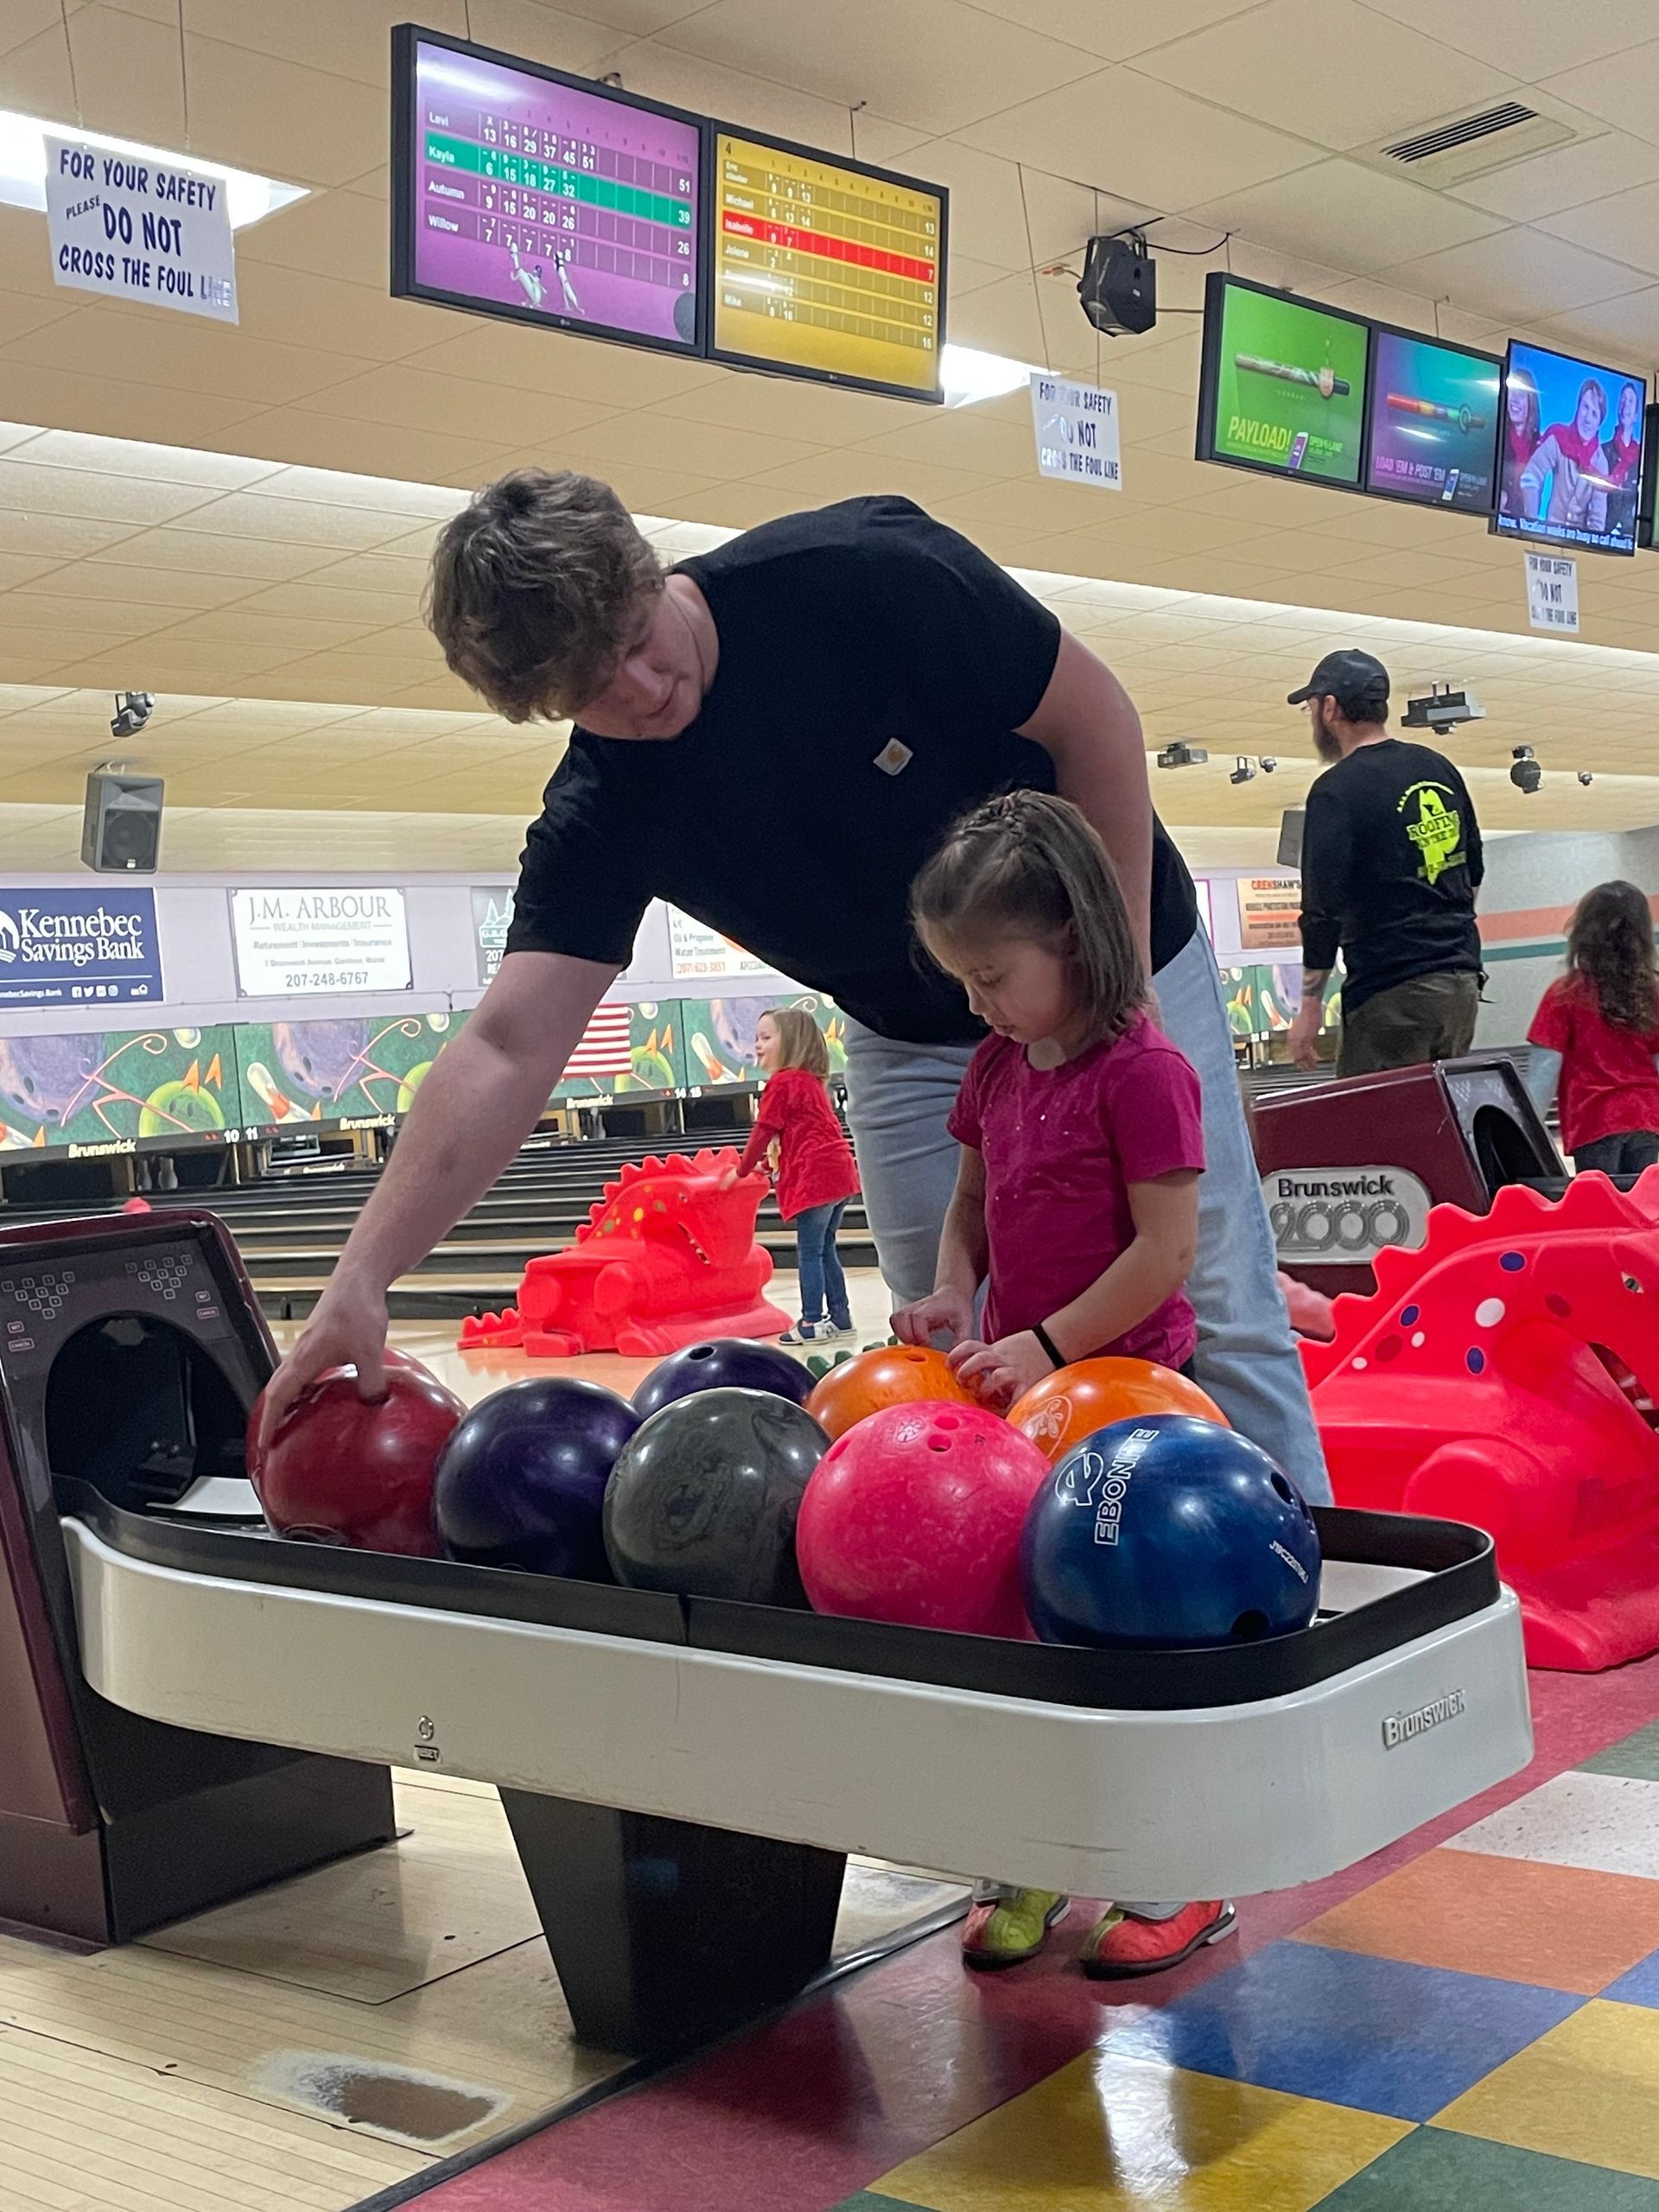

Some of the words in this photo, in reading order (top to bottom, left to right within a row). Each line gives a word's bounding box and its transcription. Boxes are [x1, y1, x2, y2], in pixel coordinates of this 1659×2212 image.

[429, 111, 448, 127] Levi
[429, 145, 455, 163] Kayla
[484, 128, 497, 143] 13
[505, 134, 517, 149] 16
[524, 139, 537, 154] 29
[543, 144, 556, 159] 37
[563, 150, 575, 165] 45
[582, 156, 594, 170] 51
[726, 142, 731, 155] 4
[60, 149, 95, 181] FOR
[103, 158, 149, 194] YOUR
[156, 172, 216, 212] SAFETY
[486, 162, 493, 175] 6
[504, 167, 517, 181] 15
[524, 172, 537, 188] 18
[543, 177, 556, 192] 27
[563, 183, 575, 198] 32
[678, 178, 690, 194] 51
[429, 181, 465, 200] Autumn
[802, 191, 811, 203] 13
[66, 194, 102, 220] PLEASE
[486, 195, 493, 209] 9
[504, 200, 517, 215] 15
[523, 205, 536, 220] 20
[543, 210, 556, 225] 20
[562, 215, 575, 230] 26
[429, 214, 459, 232] Willow
[678, 210, 690, 224] 39
[785, 212, 795, 224] 13
[801, 216, 810, 227] 14
[103, 202, 132, 245] DO
[142, 212, 181, 257] NOT
[925, 222, 935, 235] 13
[486, 229, 493, 242] 7
[505, 234, 512, 247] 7
[525, 238, 532, 251] 7
[545, 244, 552, 257] 7
[564, 249, 571, 262] 8
[677, 241, 690, 255] 26
[925, 245, 934, 257] 14
[59, 244, 115, 281] CROSS
[122, 257, 150, 288] THE
[157, 265, 194, 297] FOUL
[683, 273, 689, 286] 8
[927, 269, 933, 281] 7
[924, 291, 933, 303] 12
[923, 315, 932, 327] 12
[1084, 391, 1112, 415] SAFETY
[1077, 420, 1096, 448] NOT
[1227, 416, 1293, 452] PAYLOAD!
[1070, 452, 1083, 472] THE
[1085, 455, 1102, 476] FOUL
[1104, 461, 1118, 480] LINE
[250, 897, 289, 925] J.M.
[296, 895, 392, 919] ARBOUR
[18, 906, 143, 938] Kennebec
[273, 922, 309, 931] WEALTH
[311, 921, 372, 931] MANAGEMENT
[21, 938, 95, 967] Savings
[96, 935, 145, 960] Bank
[285, 971, 368, 988] 207-248-6767
[340, 1113, 396, 1130] Brunswick
[224, 1128, 240, 1143] 10
[245, 1126, 258, 1141] 11
[68, 1138, 137, 1158] Brunswick
[1278, 1175, 1394, 1198] Brunswick
[1269, 1199, 1410, 1252] 2000
[1382, 1689, 1465, 1751] Brunswick
